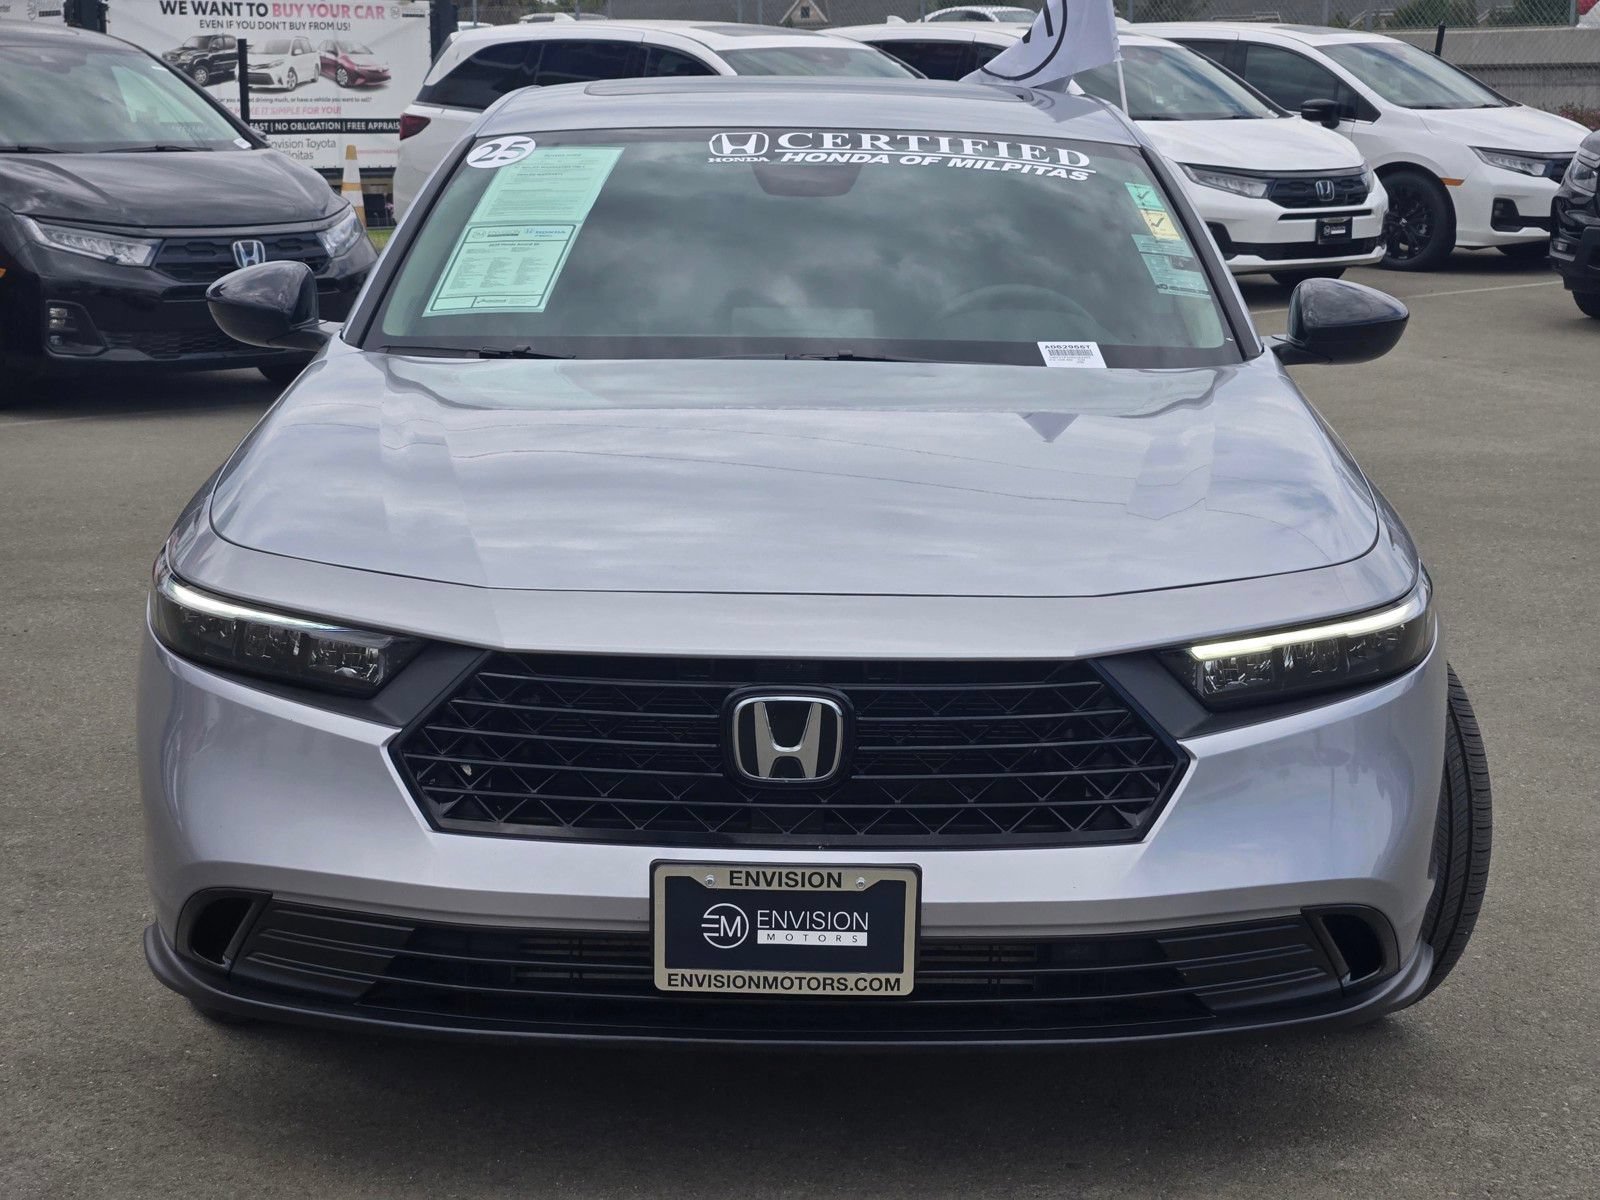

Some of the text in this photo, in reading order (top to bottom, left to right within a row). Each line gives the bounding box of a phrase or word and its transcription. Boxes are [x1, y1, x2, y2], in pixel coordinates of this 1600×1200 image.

[159, 0, 188, 15] WE
[190, 0, 244, 16] WANT
[246, 3, 269, 17] TO
[272, 3, 303, 17] BUY
[307, 4, 350, 18] YOUR
[354, 5, 385, 19] CAR
[199, 20, 351, 31] EVEN IF YOU DON'T BUY FROM US!
[249, 122, 268, 131] FAST
[275, 122, 288, 130] NO
[290, 121, 341, 131] OBLIGATION
[347, 121, 366, 130] FREE
[305, 138, 336, 150] Toyota
[470, 140, 533, 163] 25
[777, 132, 1092, 168] CERTIFIED
[780, 152, 1090, 182] HONDA OF MILPITAS
[728, 870, 842, 889] ENVISION
[757, 910, 869, 931] ENVISION
[766, 933, 858, 943] MOTORS
[667, 973, 901, 992] ENVISIONMOTORS.COM
